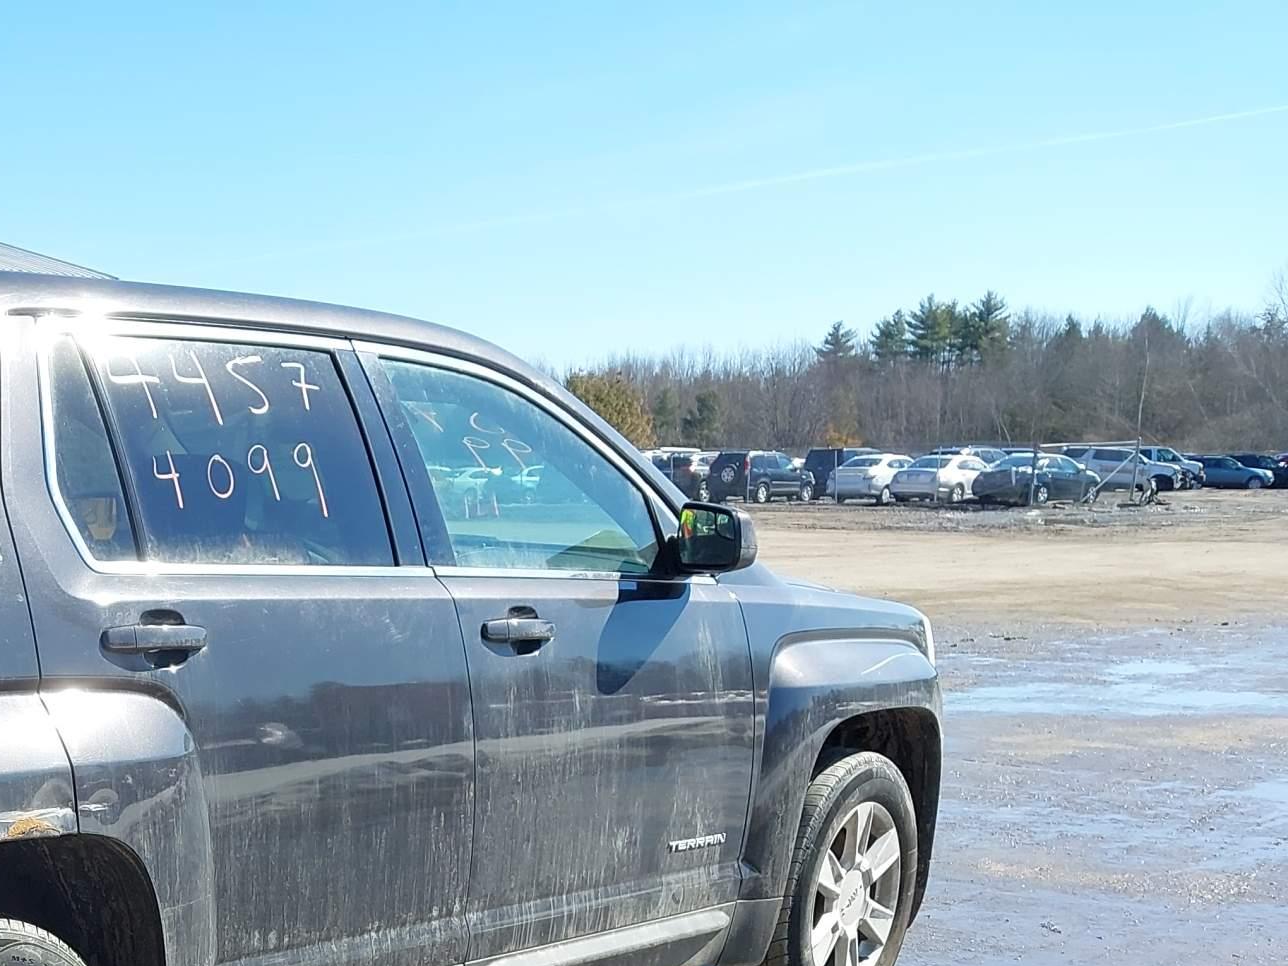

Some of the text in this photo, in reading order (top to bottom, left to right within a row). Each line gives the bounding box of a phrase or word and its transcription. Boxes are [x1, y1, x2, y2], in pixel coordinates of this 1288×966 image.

[106, 348, 320, 427] 4457
[152, 442, 329, 518] 4099
[668, 832, 727, 853] TERRAIN
